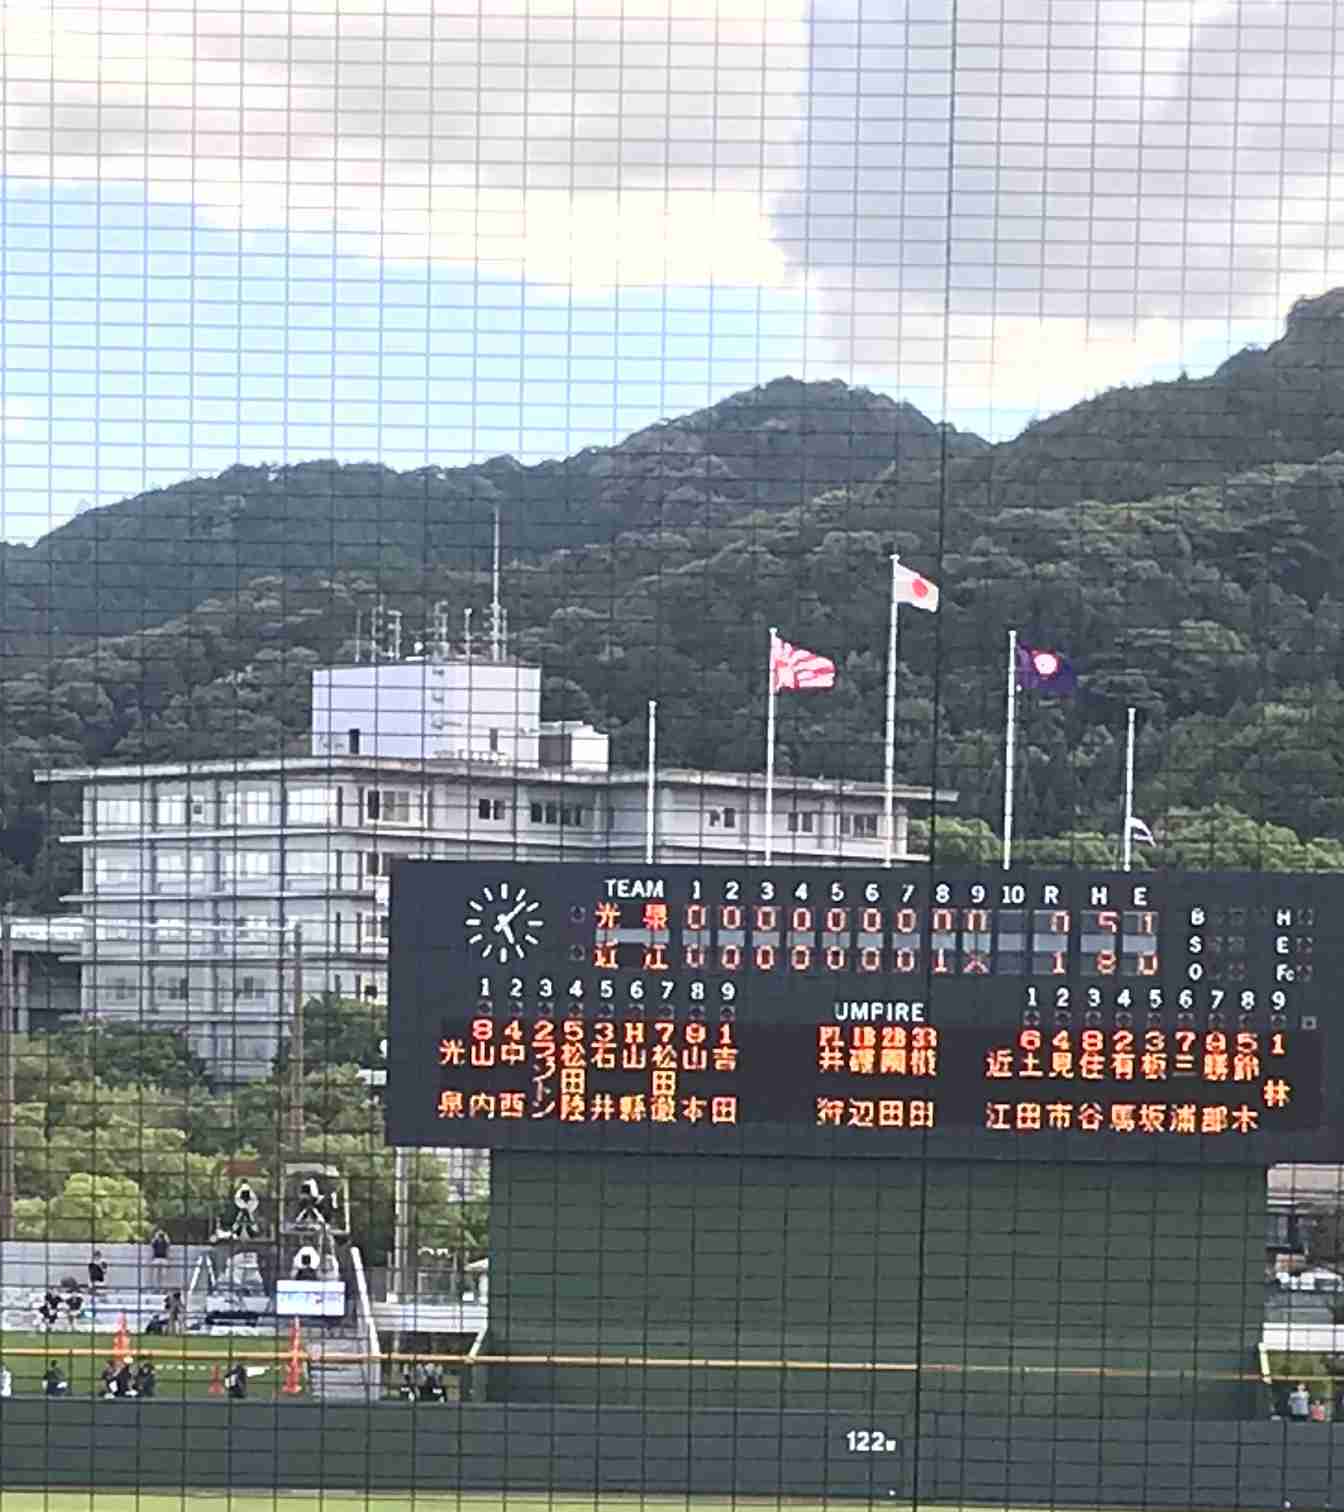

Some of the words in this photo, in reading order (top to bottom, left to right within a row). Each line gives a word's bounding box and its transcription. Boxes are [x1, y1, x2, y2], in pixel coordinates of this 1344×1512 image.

[606, 879, 664, 898] TEAM
[691, 880, 702, 900] 1
[725, 881, 740, 900] 2
[760, 882, 775, 901] 3
[794, 883, 808, 901] 4
[830, 884, 845, 901] 5
[864, 884, 879, 902] 6
[901, 884, 915, 903] 7
[935, 885, 950, 903] 8
[971, 885, 986, 903] 9
[1002, 885, 1025, 904] 10
[1044, 885, 1060, 904] R
[1091, 887, 1108, 905] H
[1133, 887, 1148, 906] E
[1191, 908, 1206, 927] B
[1276, 909, 1292, 927] H
[594, 940, 668, 969] 近江
[934, 948, 949, 972] 1
[1189, 936, 1203, 954] S
[1276, 937, 1290, 955] E
[479, 978, 491, 997] 1
[510, 979, 523, 997] 2
[539, 979, 553, 998] 3
[568, 980, 584, 998] 4
[600, 980, 614, 998] 5
[630, 981, 644, 999] 6
[660, 981, 675, 999] 7
[690, 982, 705, 1000] 8
[721, 982, 736, 1000] 9
[1027, 987, 1037, 1007] 1
[1056, 988, 1070, 1007] 2
[1087, 988, 1101, 1007] 3
[1116, 989, 1132, 1008] 4
[1149, 989, 1163, 1009] 5
[1179, 990, 1194, 1009] 6
[1210, 990, 1225, 1010] 7
[1240, 991, 1256, 1010] 8
[1272, 991, 1286, 1010] 9
[834, 1001, 925, 1022] UMPIRE
[472, 1020, 493, 1040] 8
[504, 1020, 523, 1040] 4
[534, 1021, 555, 1040] 2
[564, 1021, 585, 1041] 5
[594, 1022, 615, 1042] 3
[625, 1022, 645, 1043] H
[655, 1023, 675, 1043] 7
[718, 1024, 732, 1044] 1
[881, 1026, 907, 1047] 2B
[1019, 1030, 1041, 1050] 6
[1051, 1030, 1071, 1050] 4
[1081, 1031, 1104, 1051] 8
[1112, 1031, 1134, 1051] 2
[1144, 1032, 1165, 1052] 3
[1174, 1032, 1197, 1052] 7
[1236, 1033, 1258, 1053] 5
[1271, 1033, 1286, 1054] 1
[470, 1041, 495, 1120] 山内
[500, 1043, 525, 1118] 中西
[591, 1042, 617, 1121] 石井
[682, 1045, 707, 1122] 山本
[712, 1048, 738, 1123] 吉田
[986, 1050, 1012, 1129] 近江
[1016, 1053, 1043, 1129] 土田
[1047, 1052, 1073, 1130] 見市
[1263, 1079, 1290, 1107] 林
